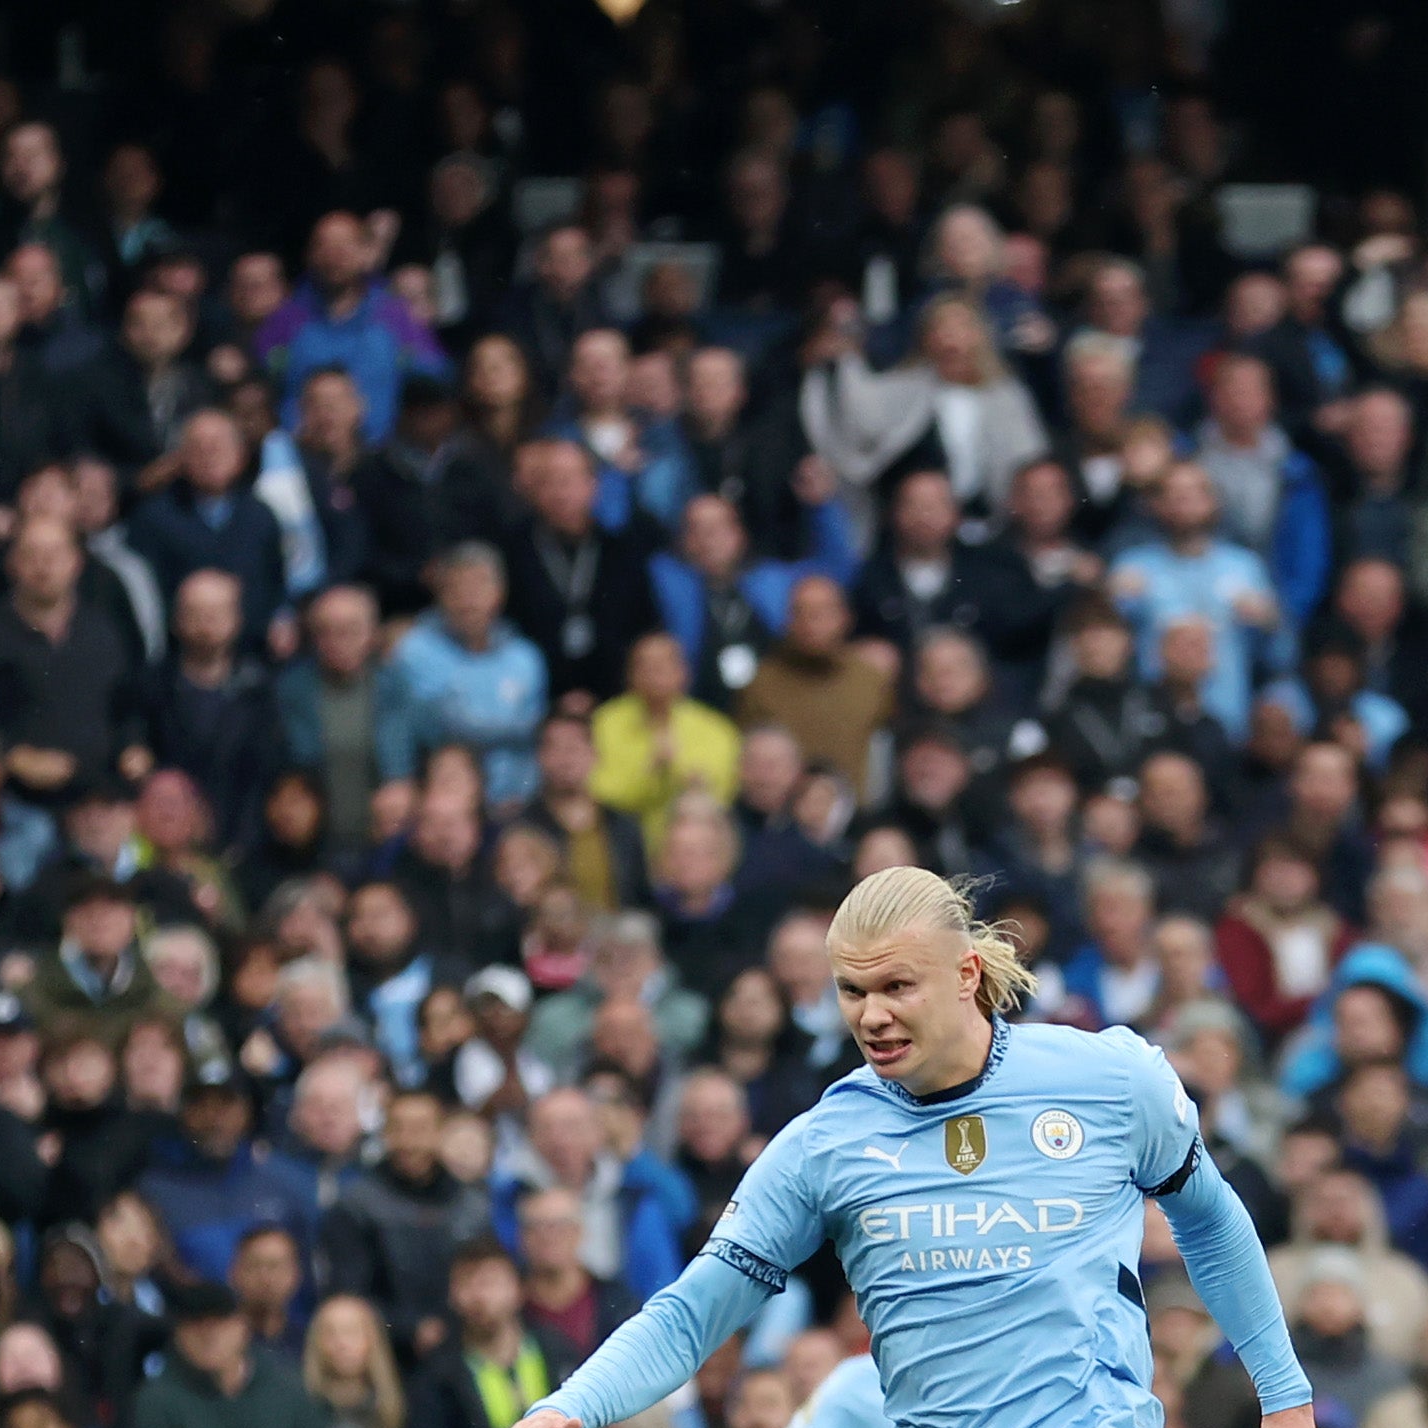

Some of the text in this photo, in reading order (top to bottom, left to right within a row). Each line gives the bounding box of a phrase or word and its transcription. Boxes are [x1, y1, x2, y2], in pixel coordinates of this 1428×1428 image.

[956, 1153, 977, 1163] FIFA
[859, 1198, 1084, 1240] ETIHAD
[901, 1246, 1032, 1272] AIRWAYS
